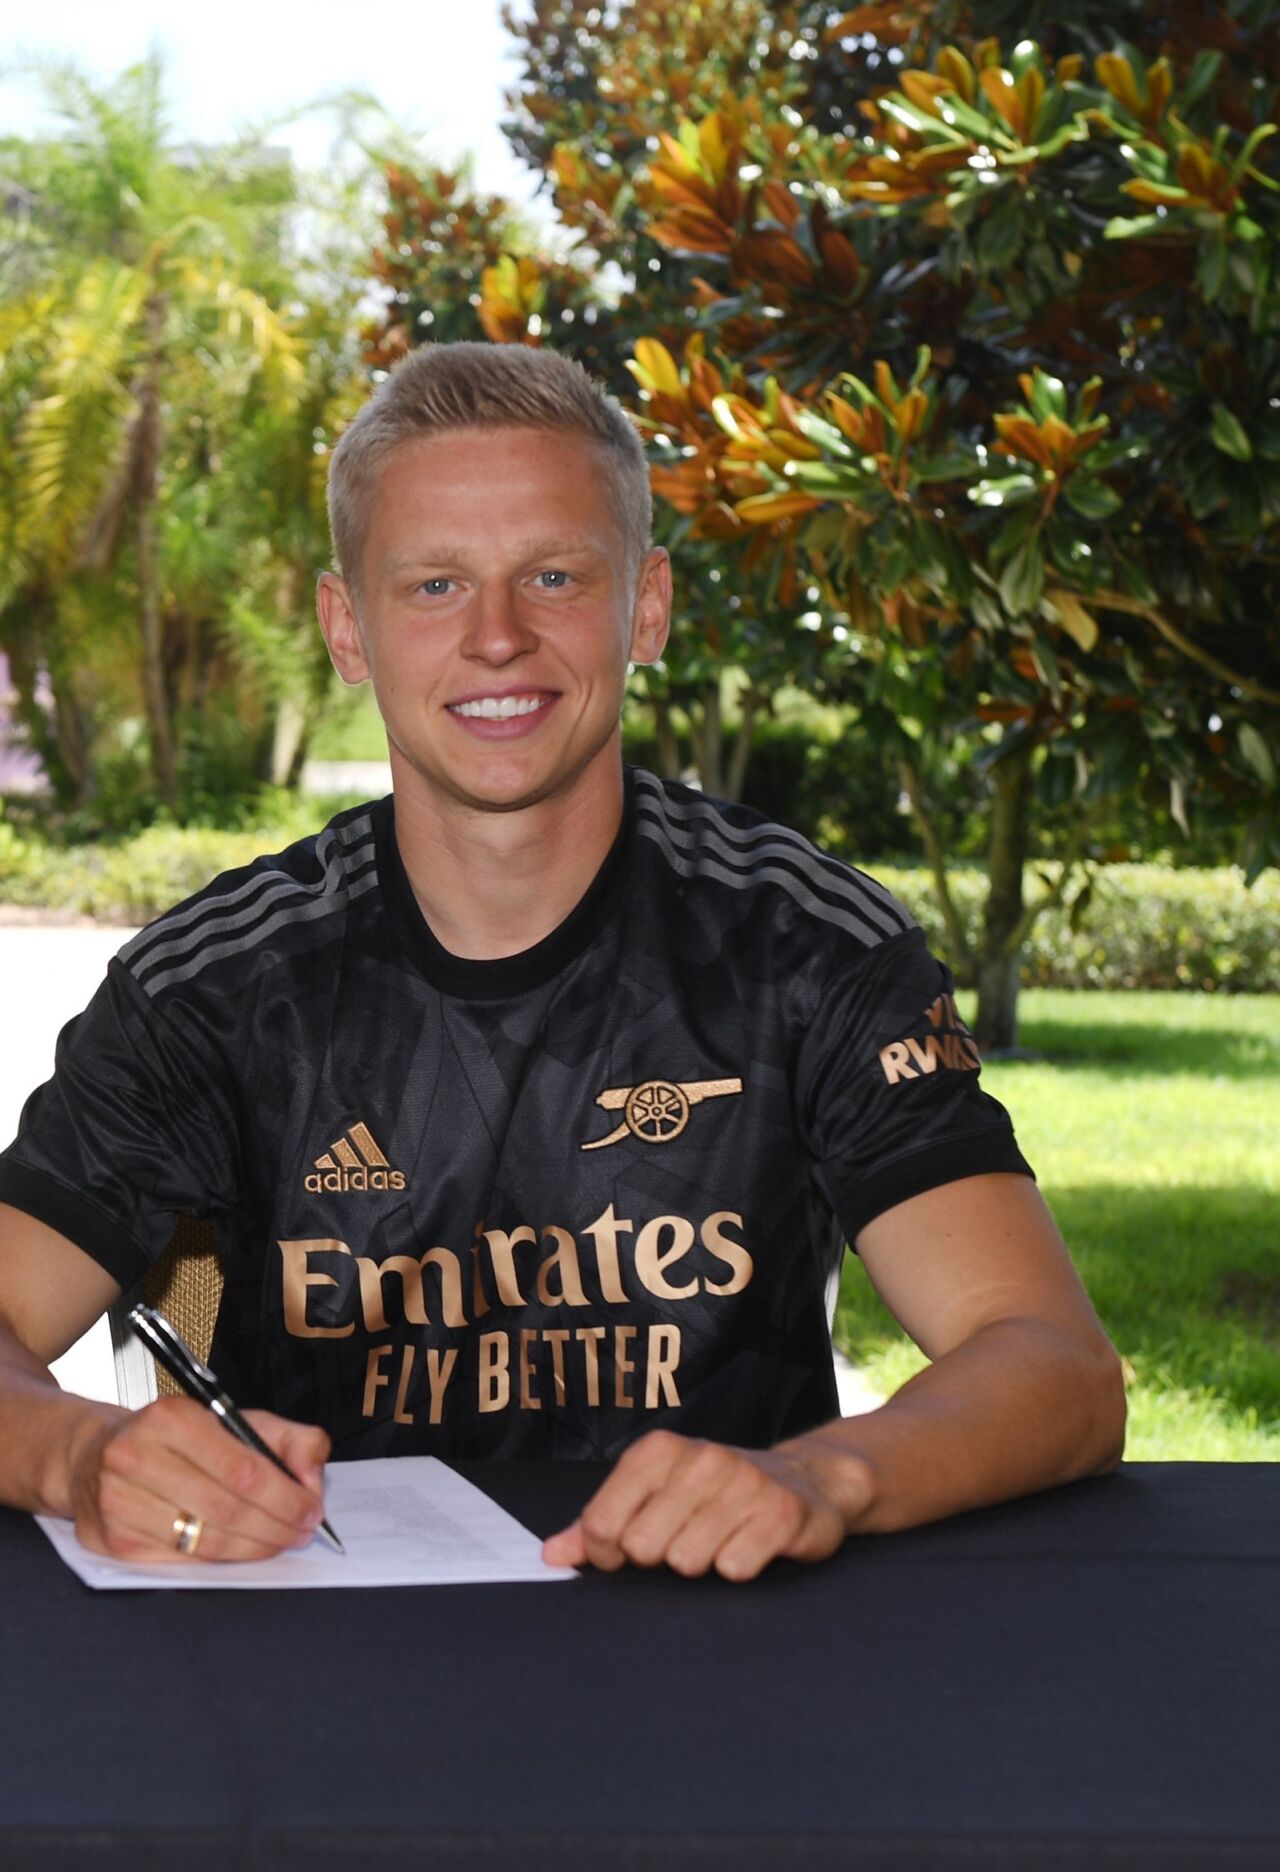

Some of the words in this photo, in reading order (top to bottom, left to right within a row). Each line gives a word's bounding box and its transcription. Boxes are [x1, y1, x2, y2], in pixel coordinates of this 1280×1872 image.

[304, 1166, 406, 1193] adidas
[276, 1202, 754, 1339] Emirates
[362, 1344, 458, 1425] FLY
[478, 1323, 682, 1414] BETTER
